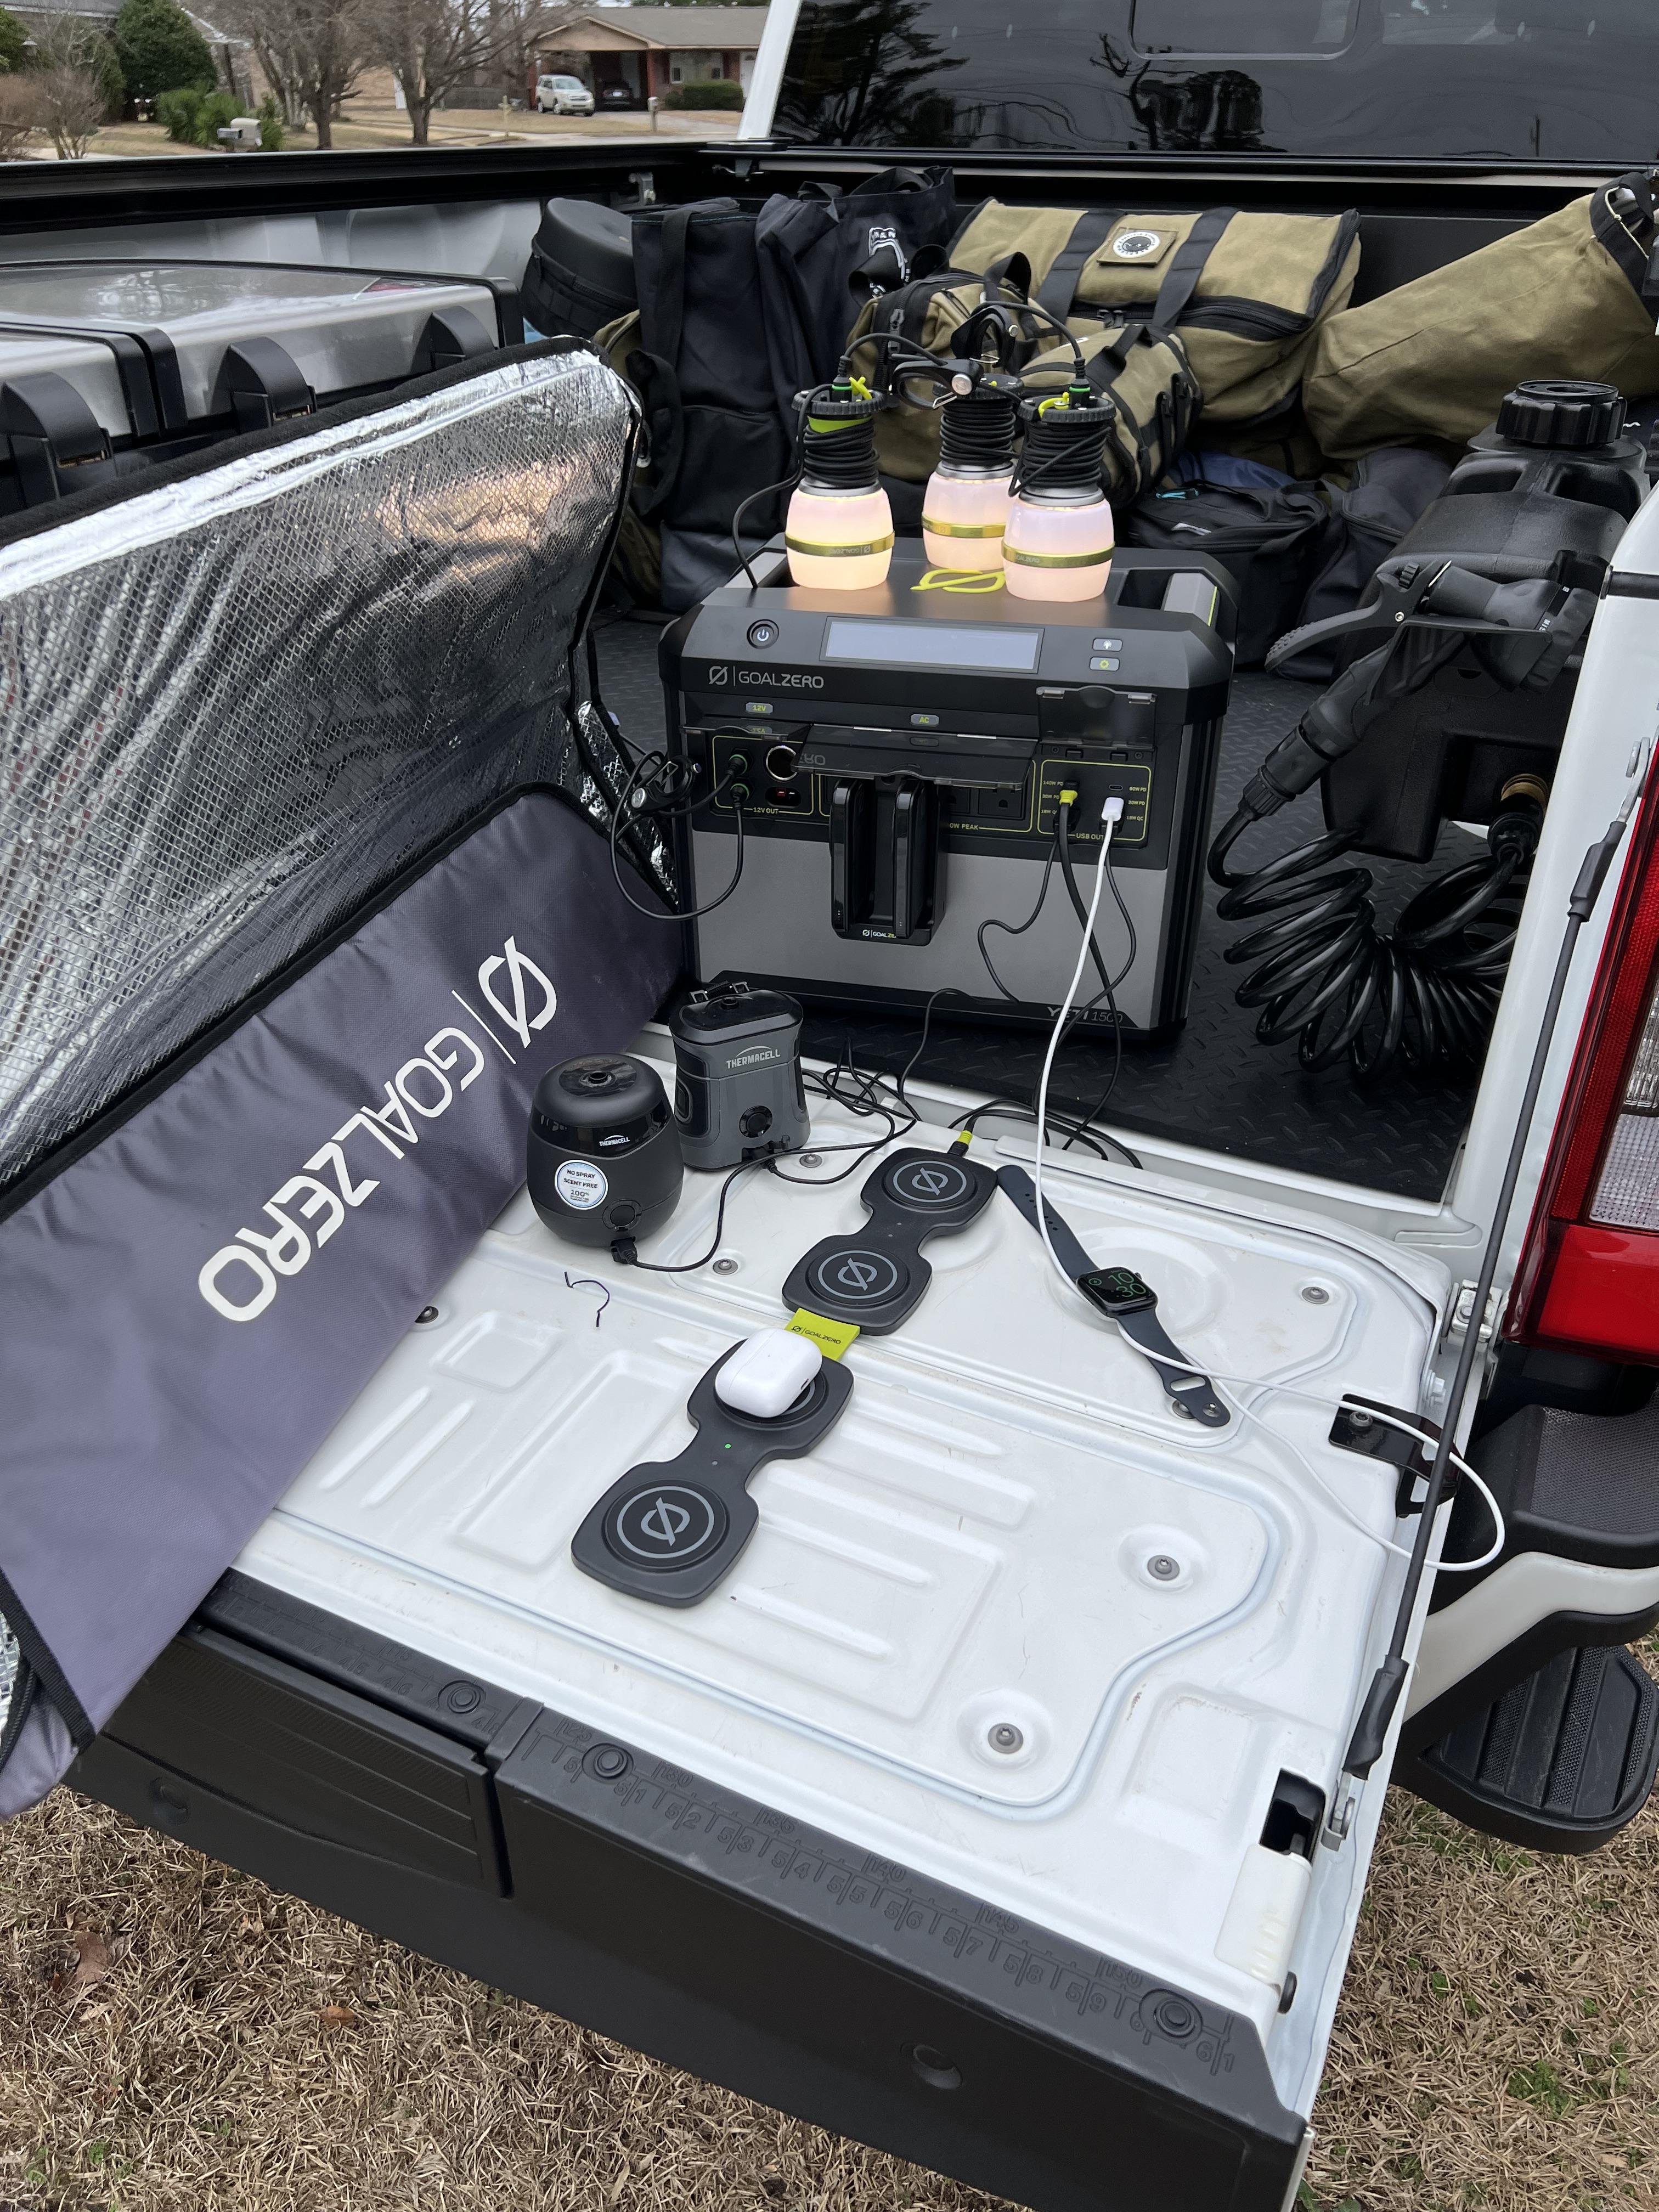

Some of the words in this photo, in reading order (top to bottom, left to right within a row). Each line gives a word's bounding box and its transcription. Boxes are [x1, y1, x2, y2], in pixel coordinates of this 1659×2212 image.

[738, 671, 824, 689] GOALZERO
[726, 1048, 781, 1069] THERMACELL
[599, 1137, 630, 1147] THERMACELL
[198, 1027, 485, 1322] GOALZERO
[564, 1178, 582, 1186] SCENT
[1108, 1272, 1135, 1285] 10
[1116, 1283, 1147, 1297] 30
[804, 1329, 842, 1345] GOALZERO
